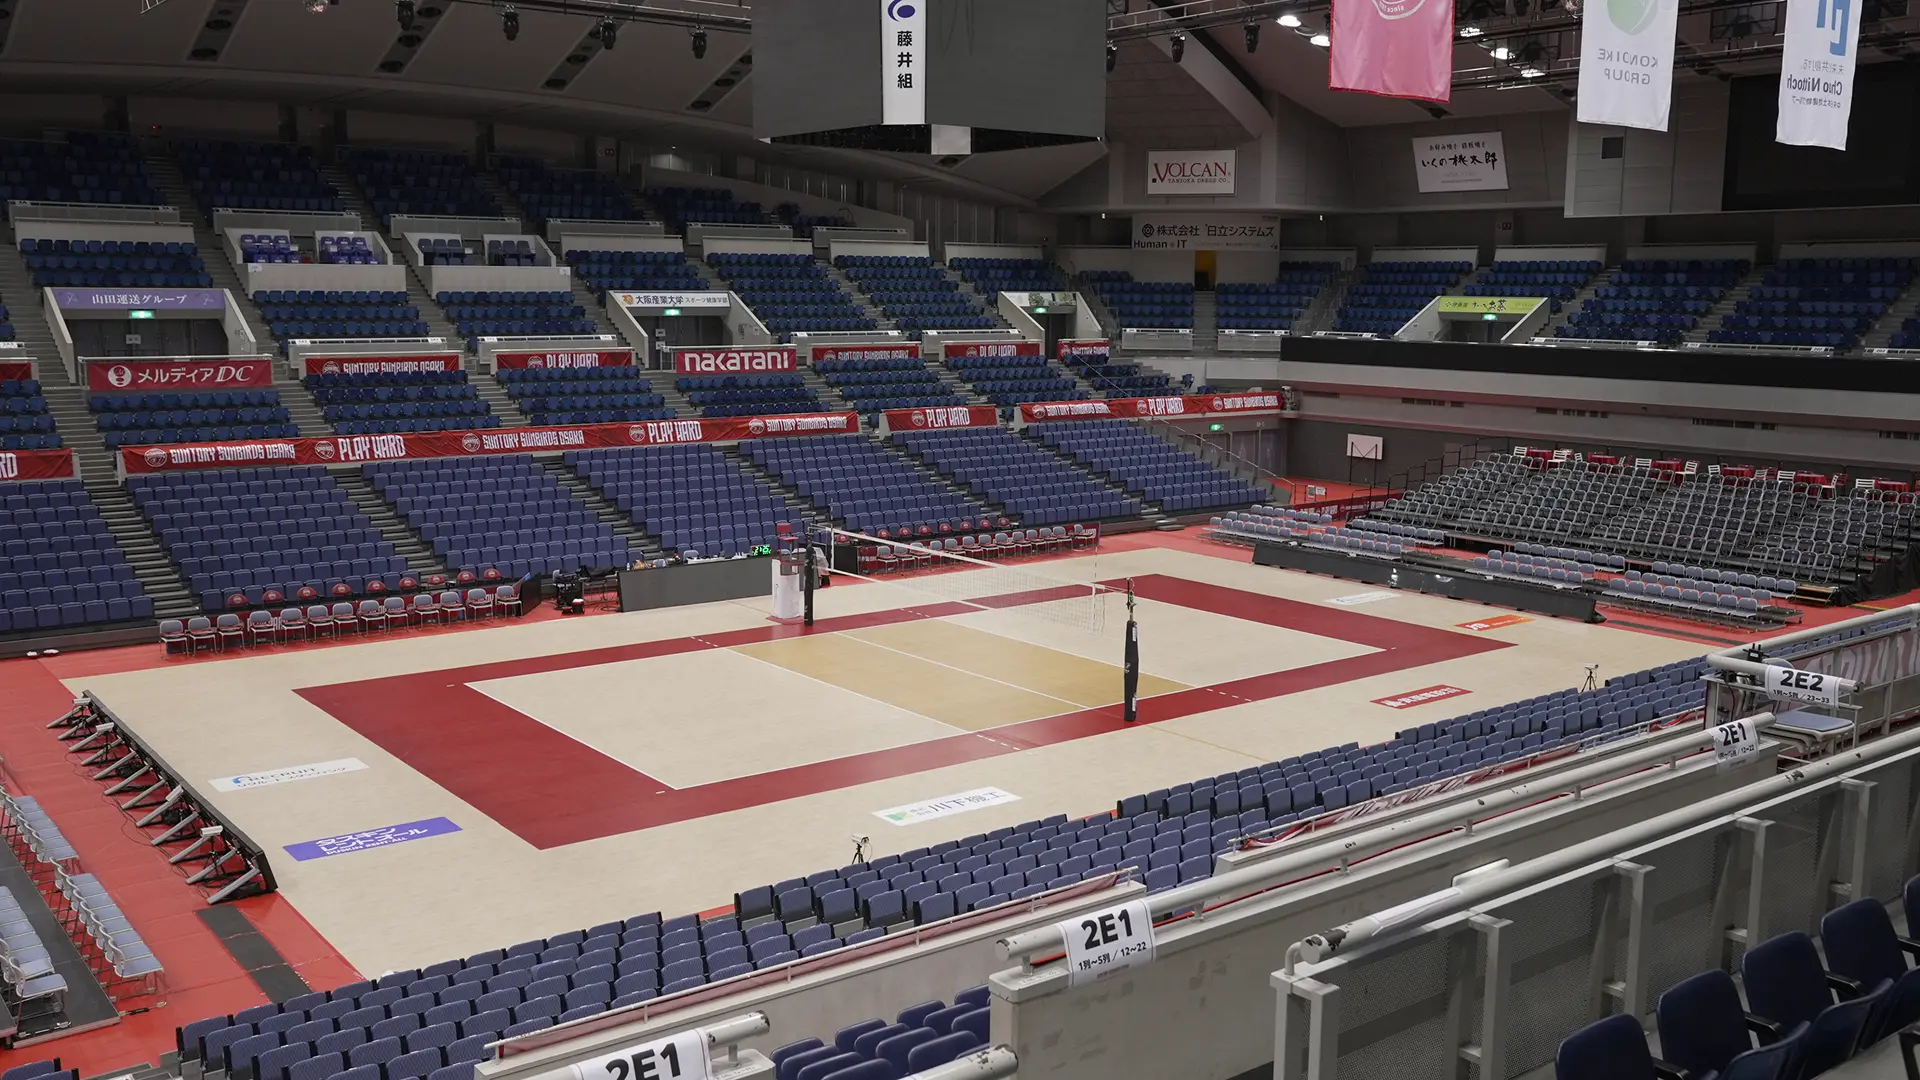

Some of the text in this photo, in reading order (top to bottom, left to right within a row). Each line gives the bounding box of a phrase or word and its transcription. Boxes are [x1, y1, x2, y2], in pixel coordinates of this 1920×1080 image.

[897, 30, 913, 89] 藤井組
[1421, 150, 1498, 171] いくの桃太郎
[1156, 224, 1276, 238] 株式会社 日立システムズ
[1133, 239, 1168, 249] Human
[1177, 239, 1188, 249] IT
[92, 293, 187, 306] 山田運送グループ
[635, 295, 684, 305] 大阪産業大学
[925, 407, 970, 428] PLAY HARD
[1147, 398, 1166, 416] PLAY
[482, 429, 585, 450] SUNTORY SUNBIRDS OSAKA
[647, 420, 703, 443] PLAY HARD
[170, 443, 296, 464] SUNTORY SUNBIRDS OSAKA
[337, 434, 406, 461] PLAY HARD
[1779, 669, 1825, 693] 2E2
[1718, 721, 1748, 747] 2E1
[319, 828, 429, 853] レントオール
[326, 836, 409, 856] DUSKIN RENT-ALL
[1080, 908, 1134, 951] 2E1
[605, 1042, 682, 1080] 2E1
